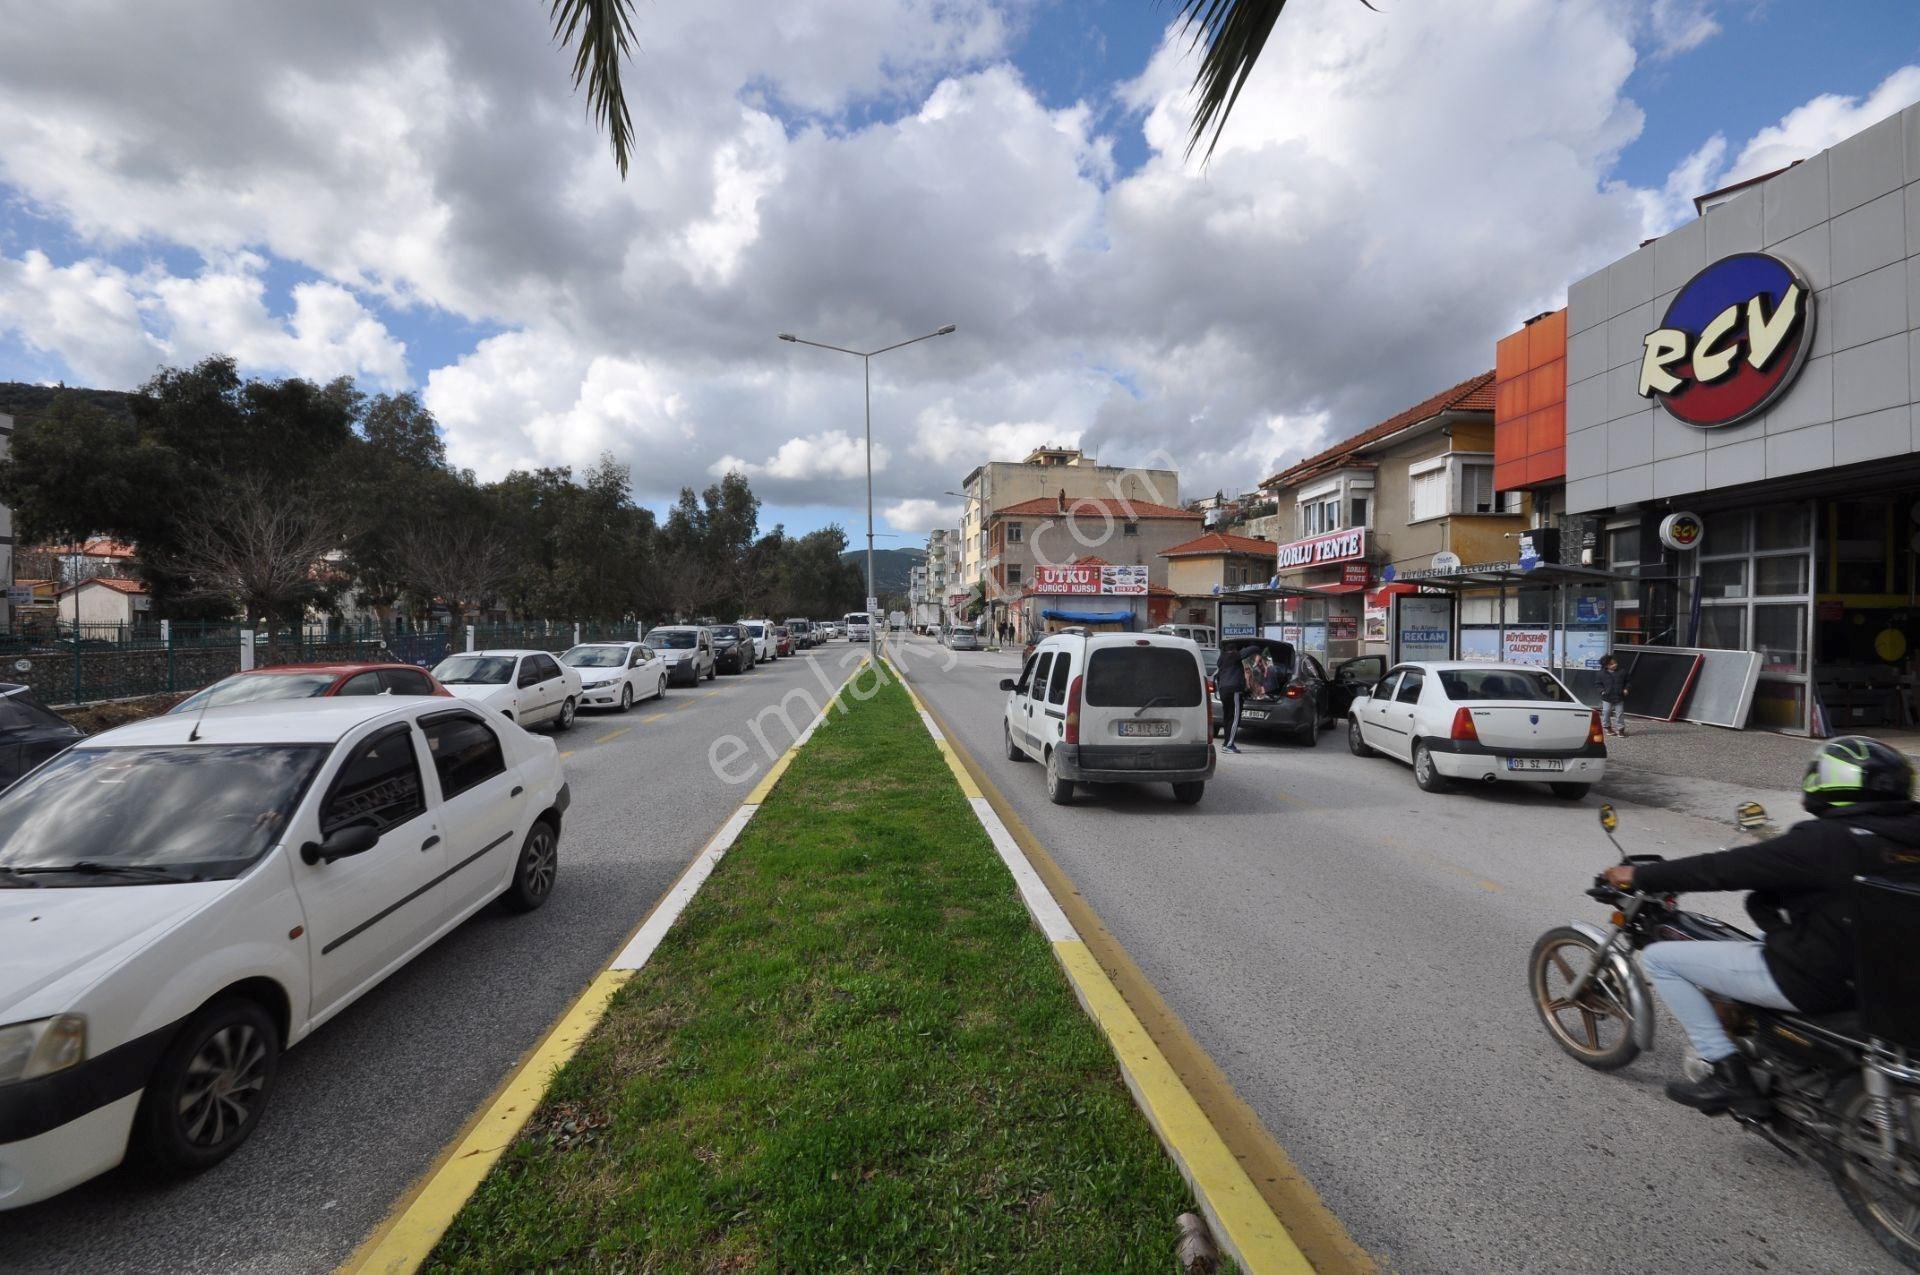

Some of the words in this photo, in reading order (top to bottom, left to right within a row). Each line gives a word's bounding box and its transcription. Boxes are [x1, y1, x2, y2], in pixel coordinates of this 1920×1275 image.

[1638, 283, 1803, 399] RCV
[1672, 524, 1699, 537] RCV
[1279, 543, 1313, 567] ZORLU
[1315, 533, 1359, 560] TENTE
[1043, 570, 1090, 583] UTKU
[1072, 584, 1097, 593] KURSU
[1404, 632, 1445, 641] REKLAM
[1506, 632, 1547, 643] BÜYÜKŞEHİR
[1530, 759, 1541, 769] SZ
[1548, 760, 1561, 769] 771
